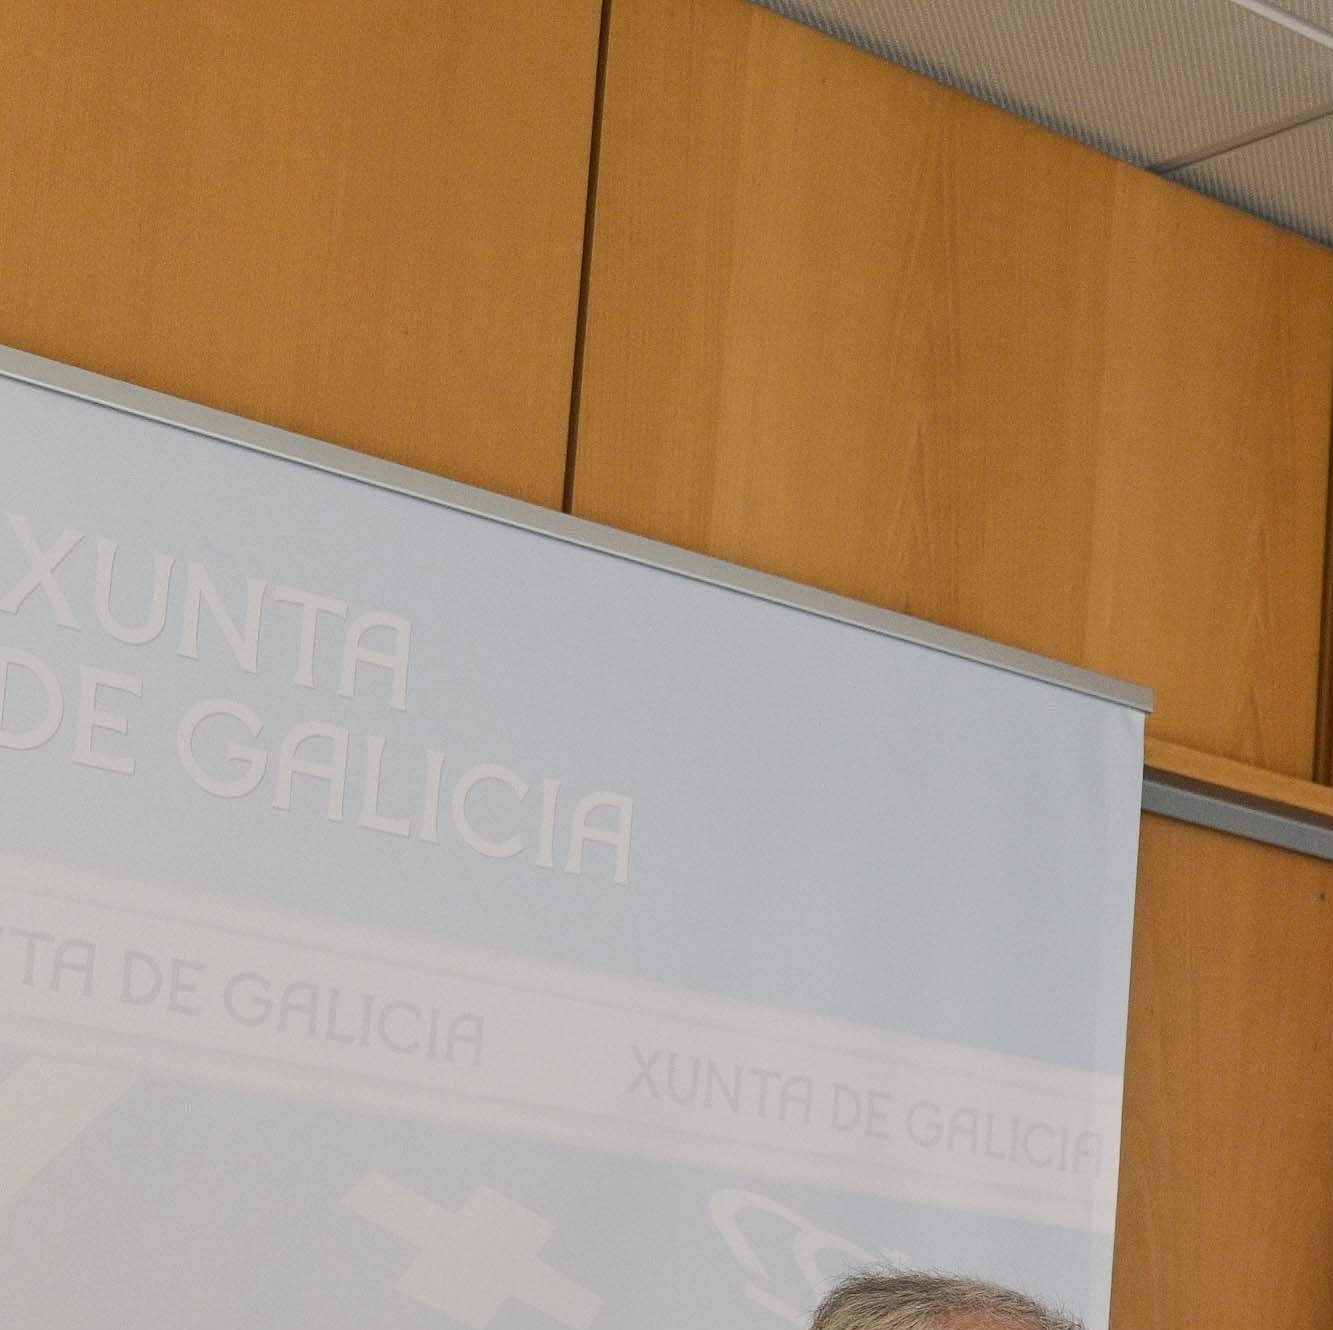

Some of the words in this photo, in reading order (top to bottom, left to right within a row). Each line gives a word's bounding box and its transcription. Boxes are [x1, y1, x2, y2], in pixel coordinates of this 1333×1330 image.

[0, 513, 414, 712] XUNTA
[0, 647, 143, 776] DE
[177, 698, 635, 886] GALICIA
[0, 926, 96, 998] TA
[120, 950, 206, 1016] DE
[223, 971, 485, 1067] GALICIA
[626, 1043, 815, 1127] XUNTA
[831, 1082, 895, 1140] DE
[906, 1099, 1104, 1176] GALICIA
